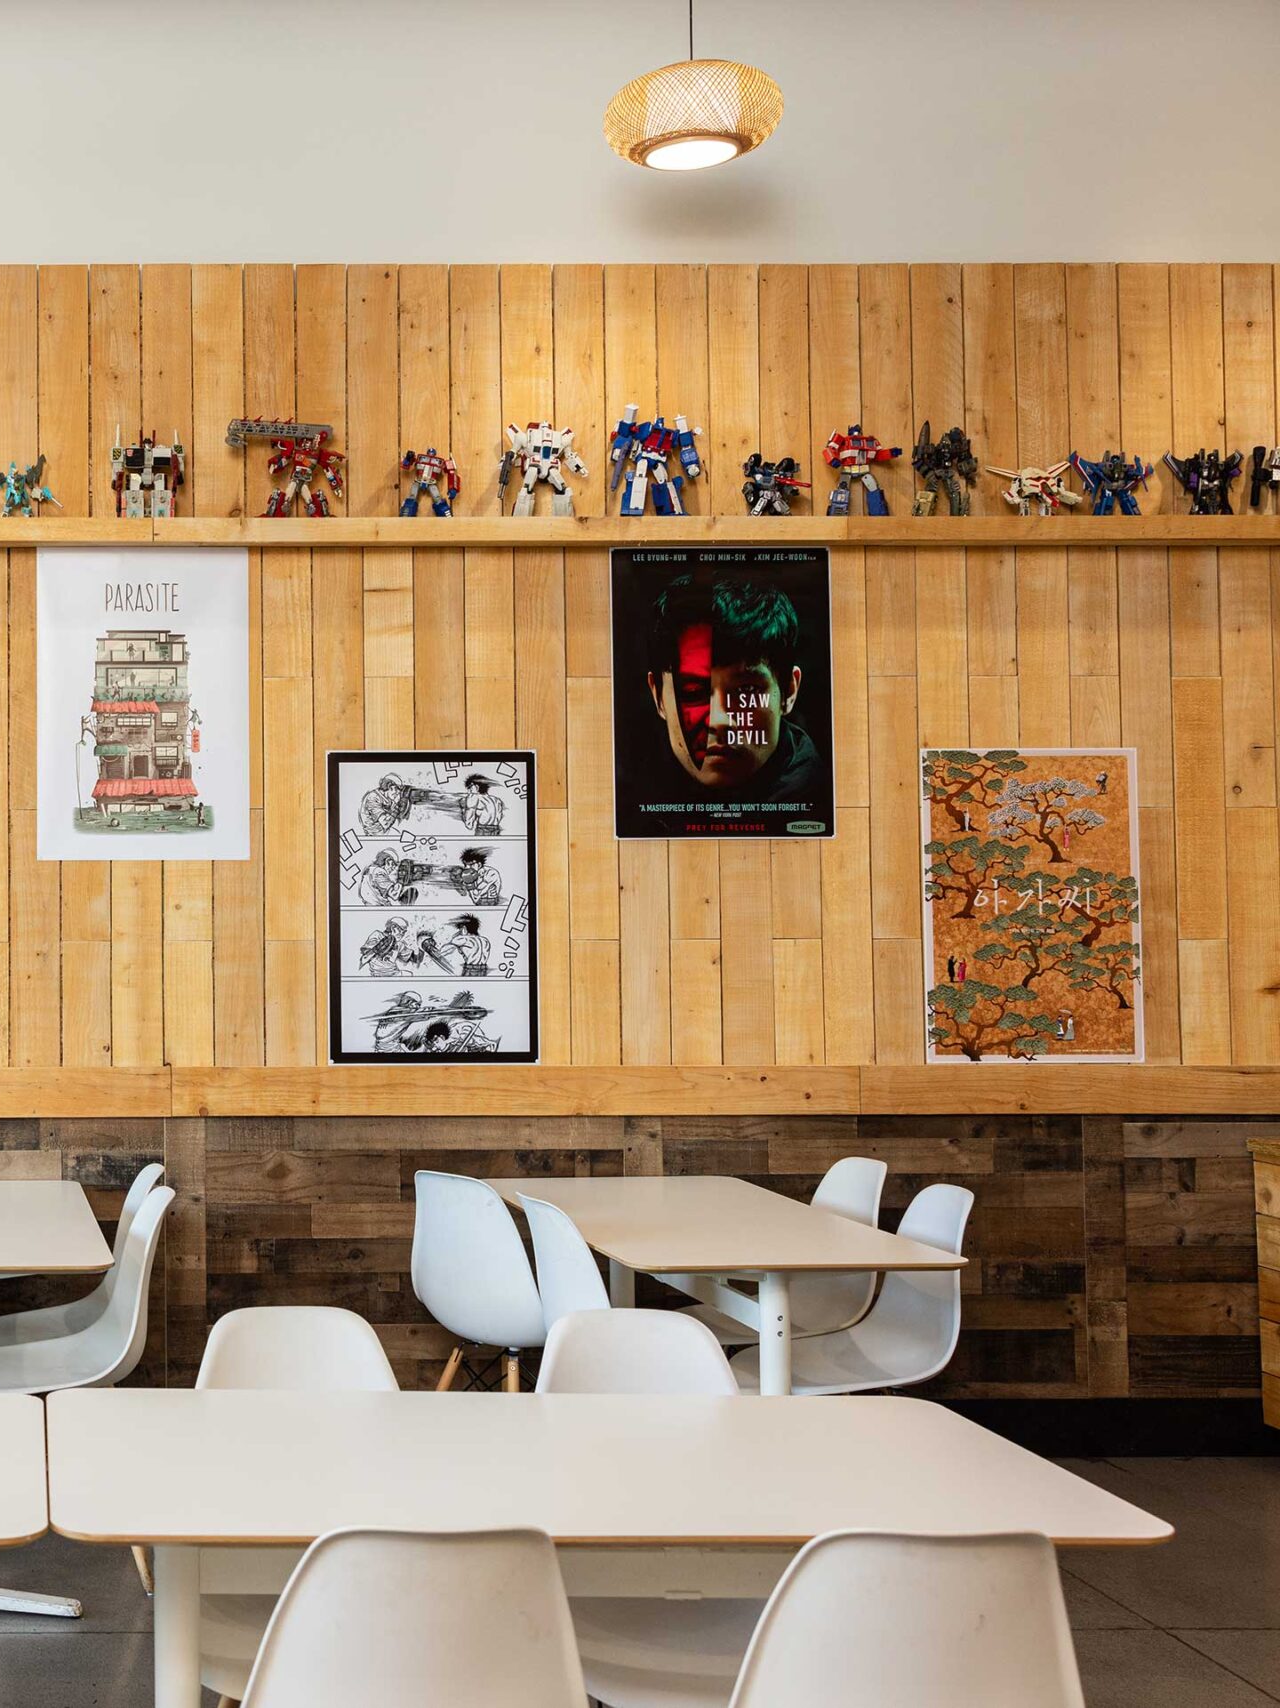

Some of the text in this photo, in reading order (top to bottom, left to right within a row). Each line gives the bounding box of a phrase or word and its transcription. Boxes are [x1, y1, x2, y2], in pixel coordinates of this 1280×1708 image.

[633, 553, 645, 562] LEE
[105, 583, 180, 613] PARASITE
[726, 693, 770, 709] I SAW
[726, 711, 754, 727] THE
[727, 730, 768, 745] DEVIL
[646, 803, 685, 812] MASTERPIECE
[686, 803, 695, 812] OF
[695, 803, 705, 812] ITS
[741, 803, 760, 812] WON'T
[761, 803, 777, 812] SOON
[778, 803, 800, 812] FORGET
